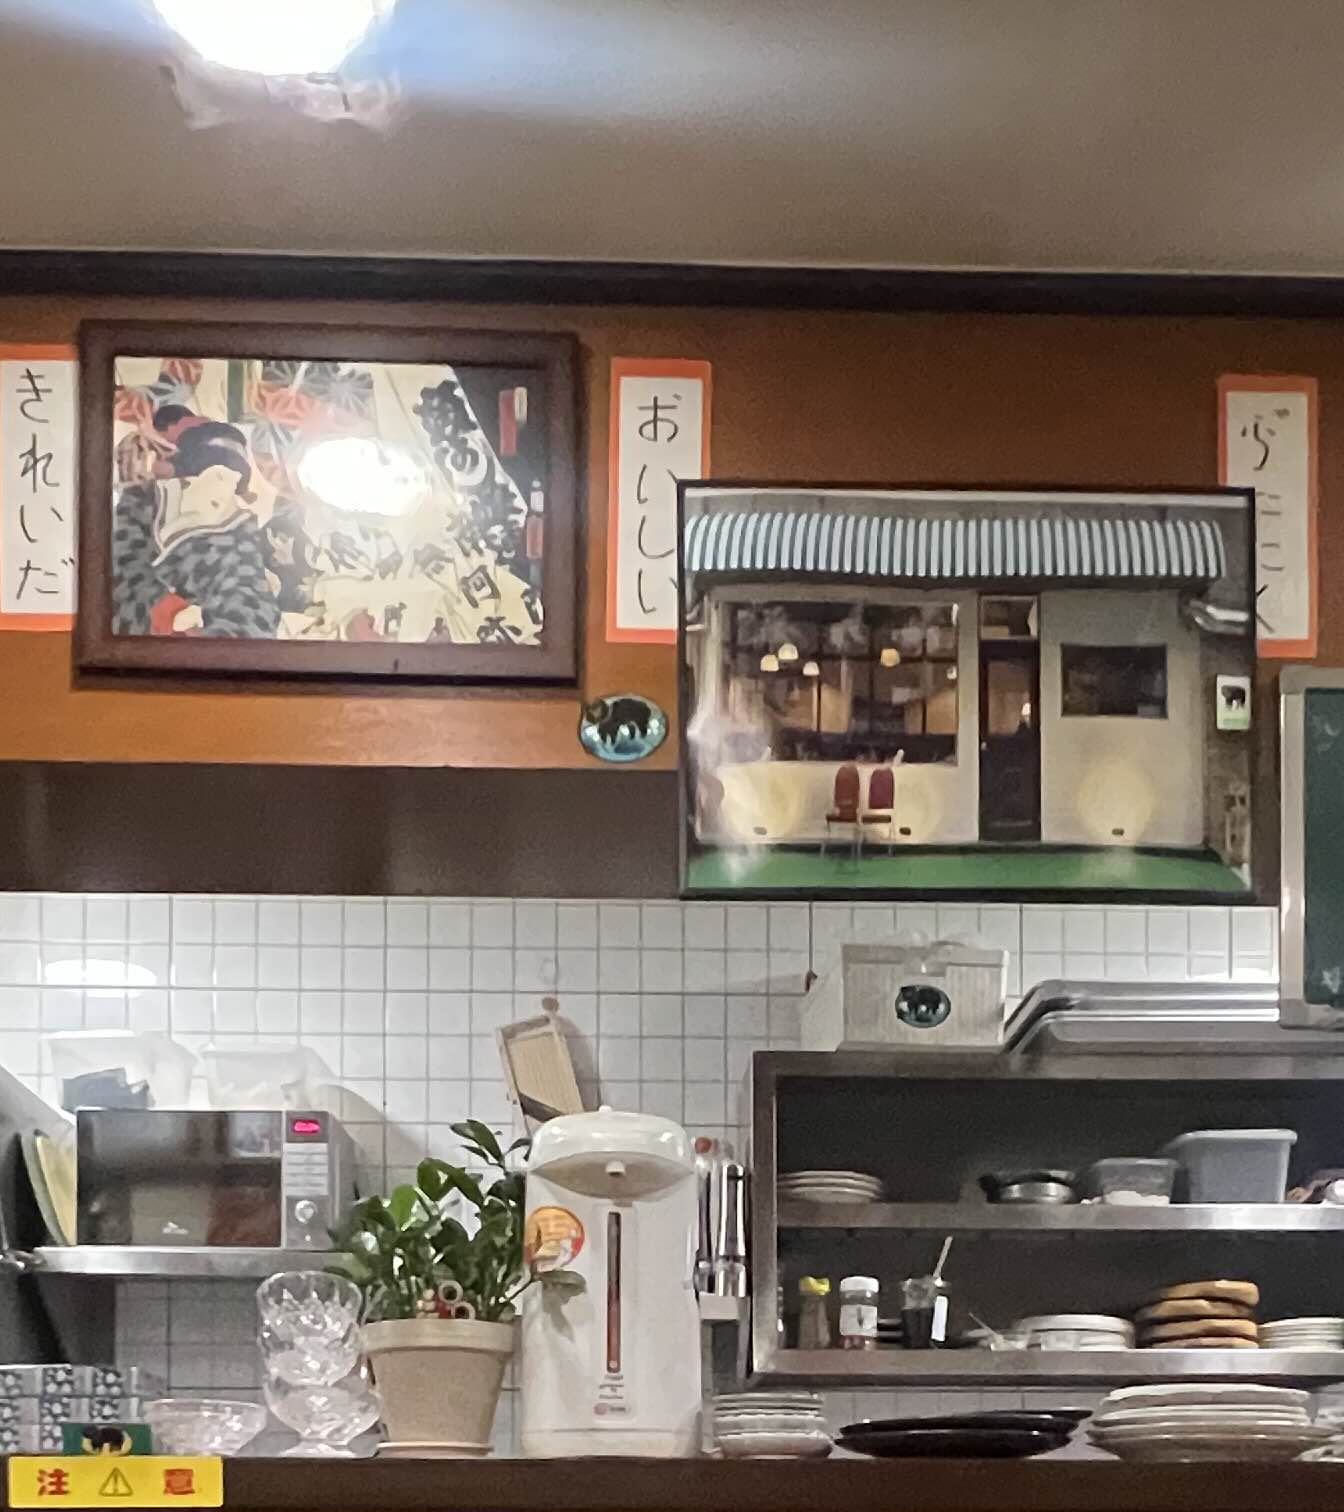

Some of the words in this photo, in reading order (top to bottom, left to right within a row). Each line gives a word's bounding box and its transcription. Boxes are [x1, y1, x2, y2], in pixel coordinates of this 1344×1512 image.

[16, 368, 76, 601] きれいだ
[635, 393, 681, 616] おいしい
